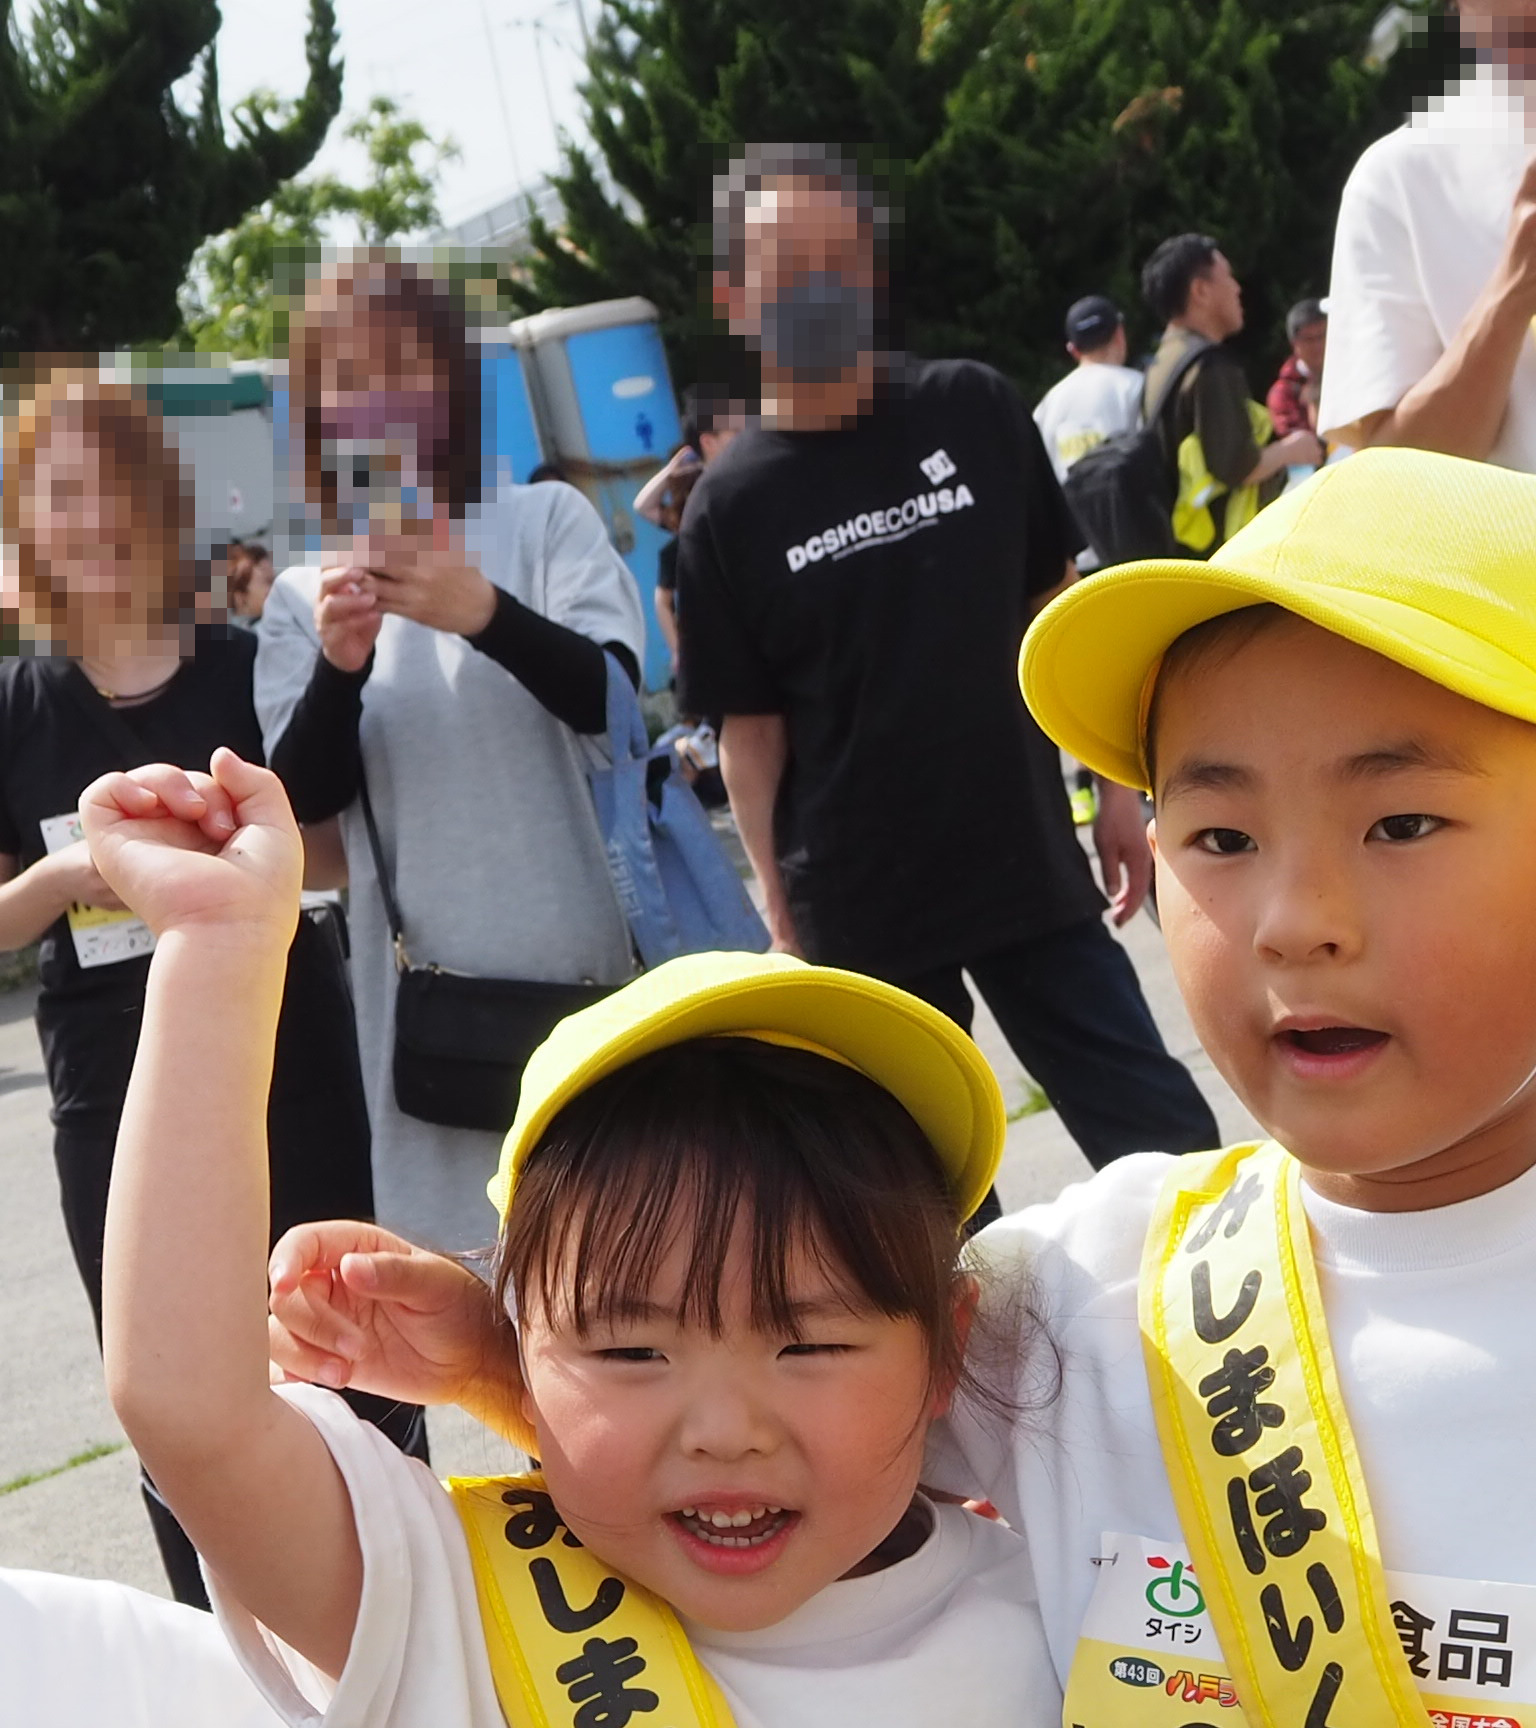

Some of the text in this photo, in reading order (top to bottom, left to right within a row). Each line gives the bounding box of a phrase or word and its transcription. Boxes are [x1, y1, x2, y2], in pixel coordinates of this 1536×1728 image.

[1145, 1617, 1202, 1644] タイシ
[1114, 1661, 1161, 1685] 第43回
